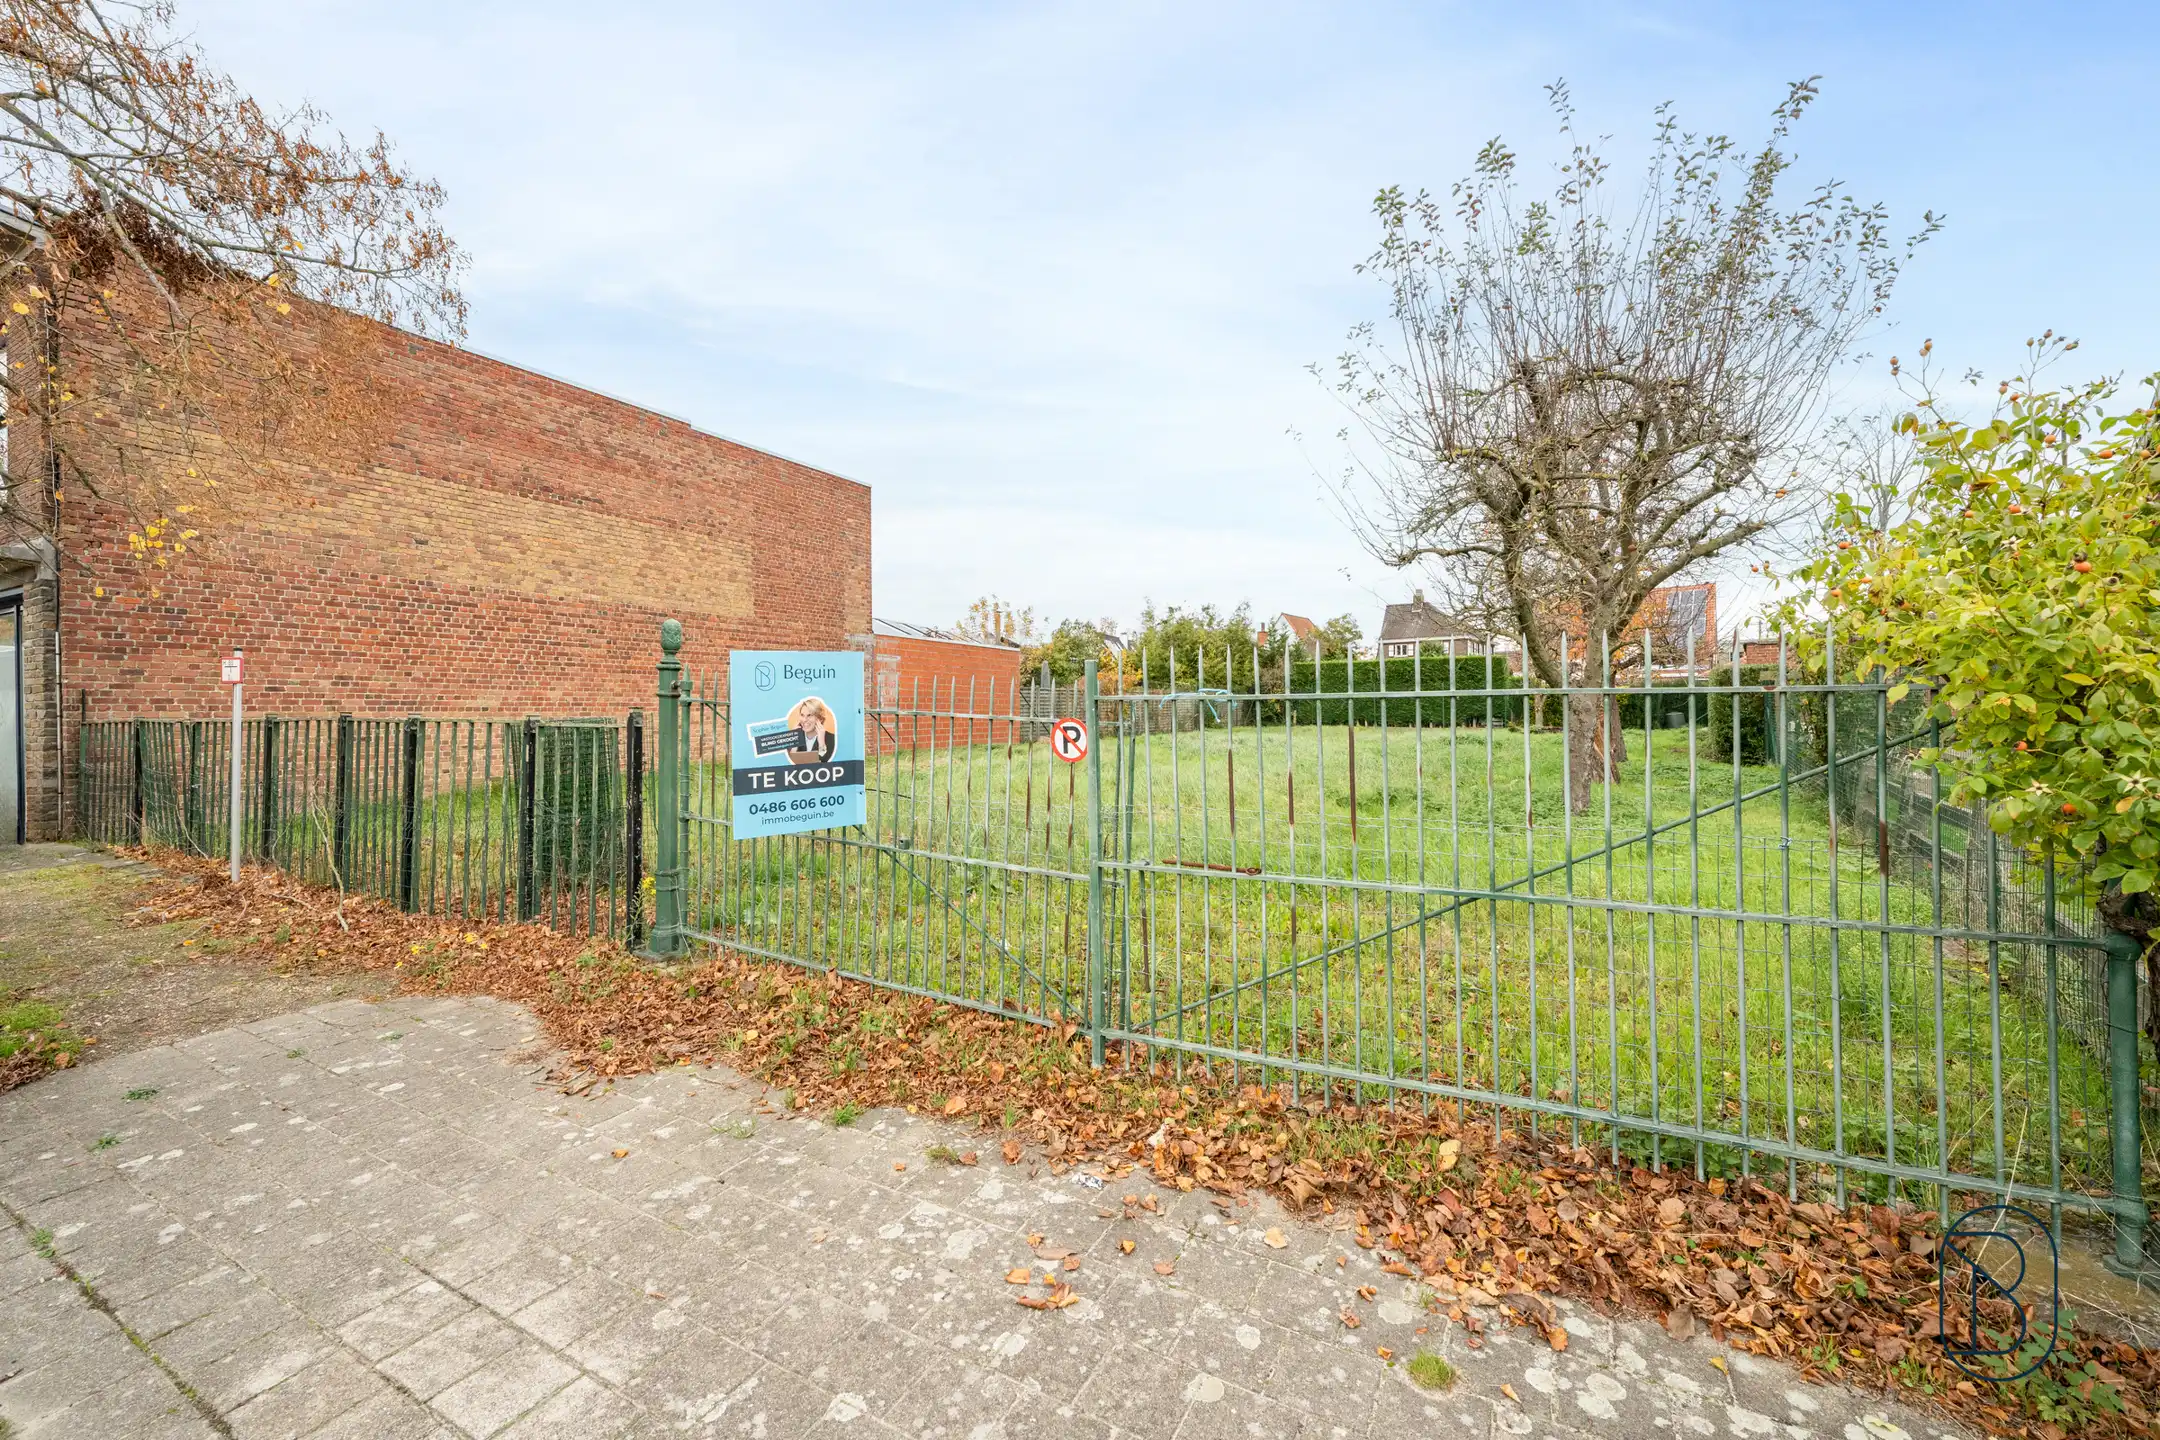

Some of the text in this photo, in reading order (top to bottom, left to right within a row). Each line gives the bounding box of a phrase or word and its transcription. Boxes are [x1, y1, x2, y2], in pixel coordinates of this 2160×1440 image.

[784, 664, 836, 684] Beguin
[1063, 726, 1081, 754] P
[748, 766, 845, 789] TE KOOP
[749, 795, 845, 815] 0486 606 600
[761, 810, 834, 826] immobeguin.be
